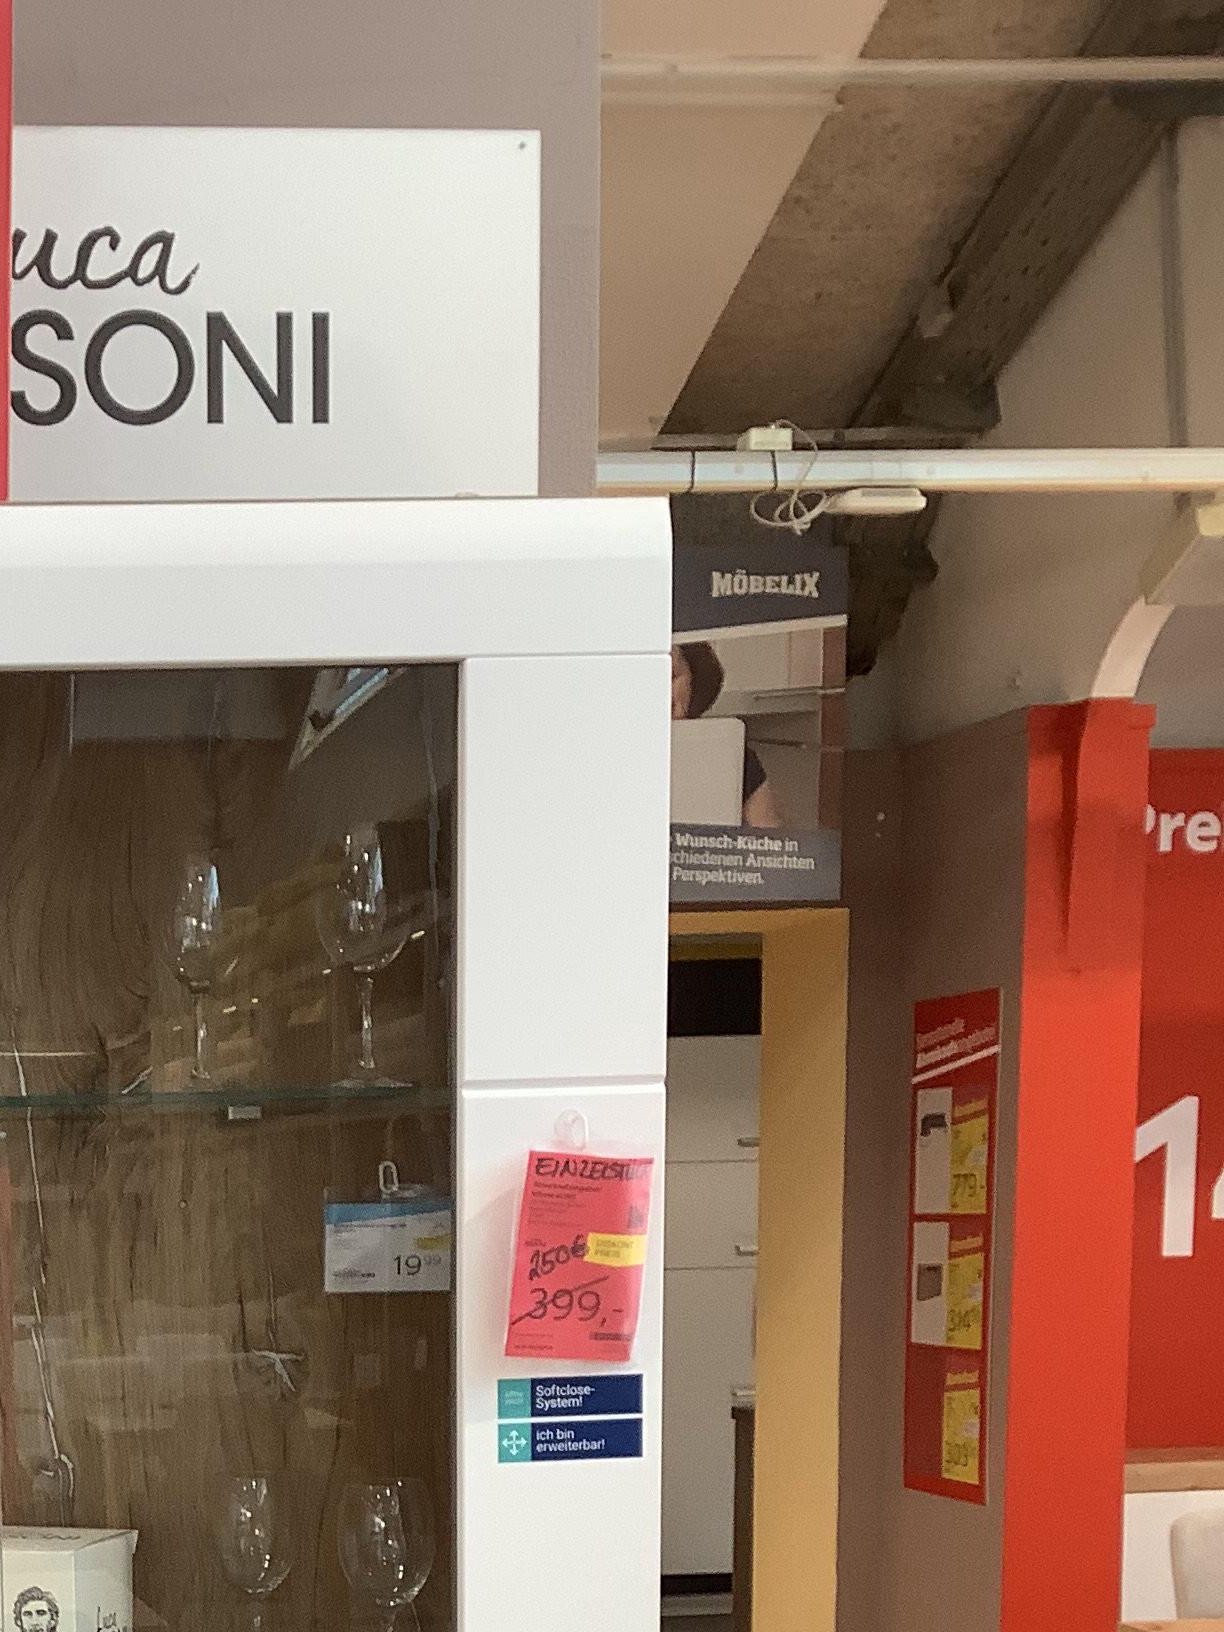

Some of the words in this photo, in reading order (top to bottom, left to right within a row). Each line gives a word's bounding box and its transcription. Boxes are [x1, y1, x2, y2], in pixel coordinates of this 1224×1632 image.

[12, 226, 200, 295] uca
[12, 308, 330, 426] SONI
[711, 569, 820, 598] MÖBELIX
[675, 833, 782, 851] Wunsch-Küche
[785, 837, 799, 852] in
[746, 853, 815, 870] Ansichten
[1135, 1095, 1224, 1257] 1
[526, 1287, 623, 1327] 399,-
[536, 1384, 595, 1397] Softclose-
[536, 1396, 583, 1411] System!
[556, 1428, 574, 1440] bin
[536, 1439, 605, 1453] erweiterbar!
